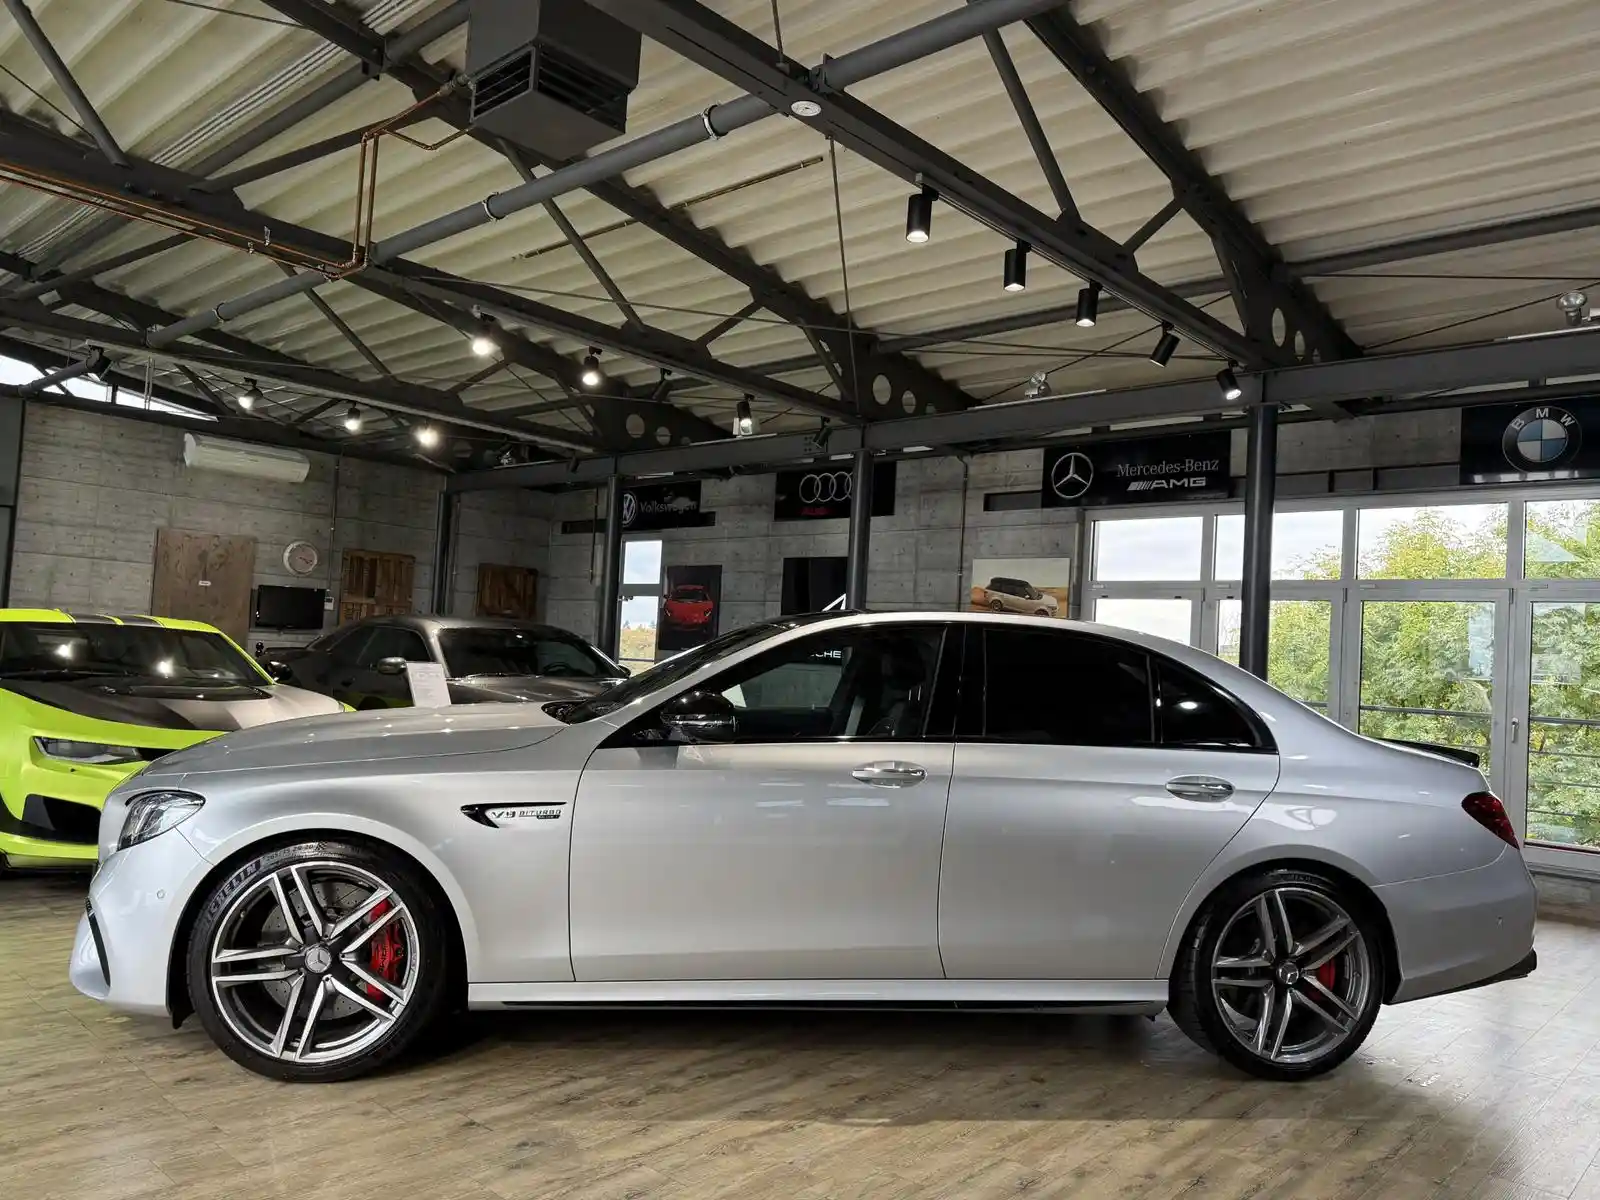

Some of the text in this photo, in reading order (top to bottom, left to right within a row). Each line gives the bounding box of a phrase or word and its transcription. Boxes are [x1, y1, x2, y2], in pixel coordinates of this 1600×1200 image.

[1511, 408, 1576, 430] BMW
[1116, 459, 1219, 477] Mercedes-Benz
[1150, 477, 1207, 489] AMG
